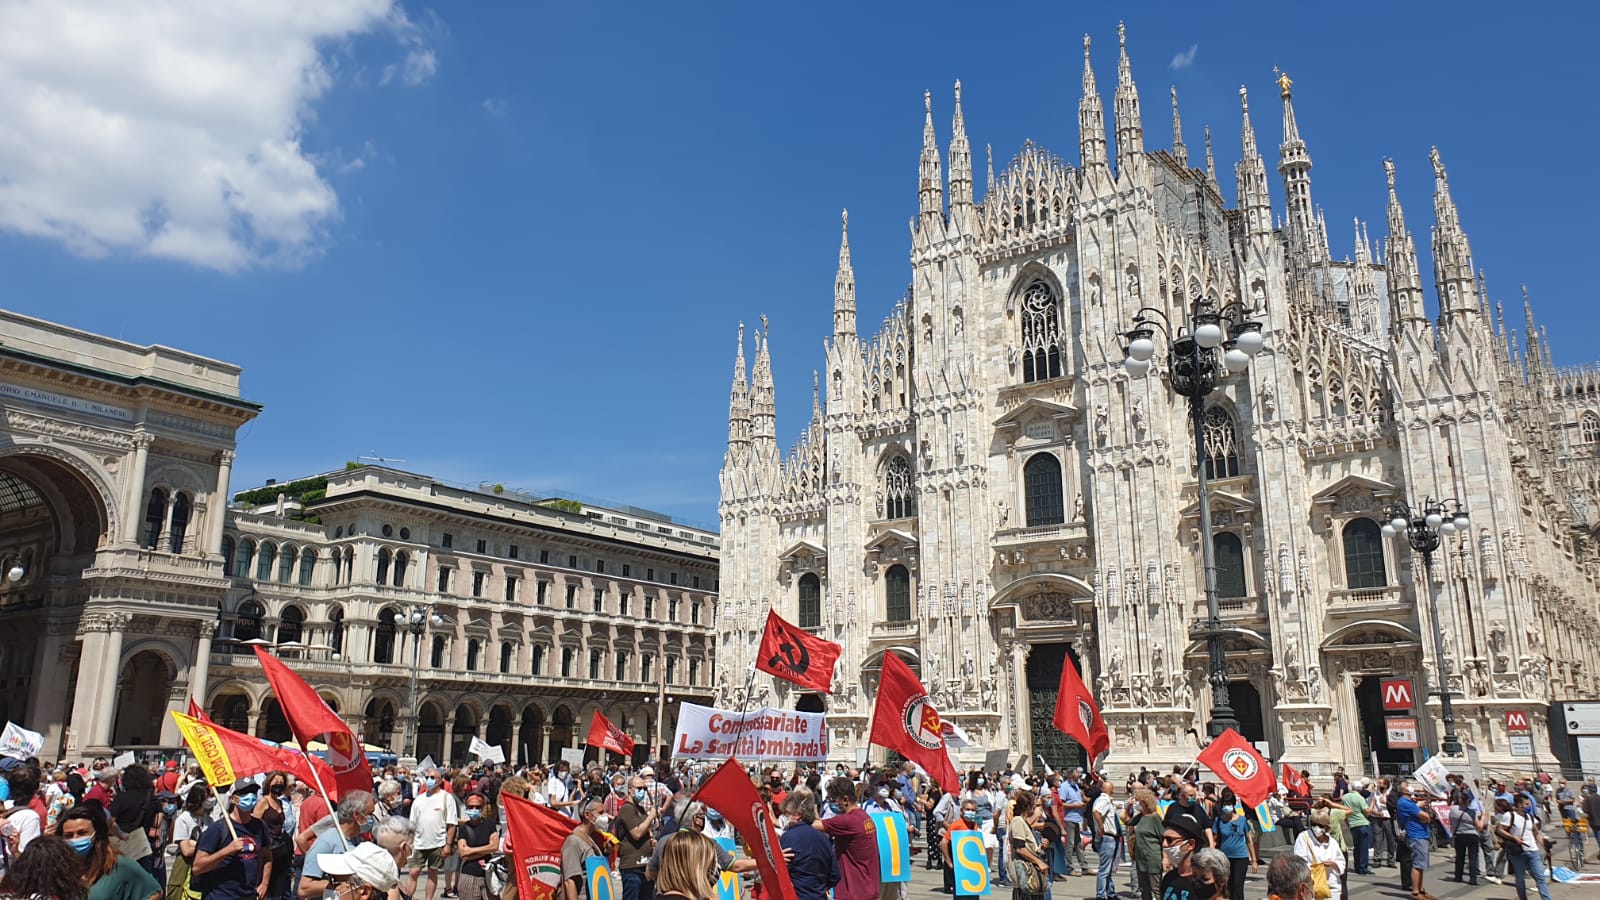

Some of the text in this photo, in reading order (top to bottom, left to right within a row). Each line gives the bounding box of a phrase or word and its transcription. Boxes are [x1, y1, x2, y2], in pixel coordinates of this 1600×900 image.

[1385, 685, 1411, 703] M
[1508, 714, 1527, 727] M
[679, 733, 703, 754] La
[957, 836, 987, 892] S
